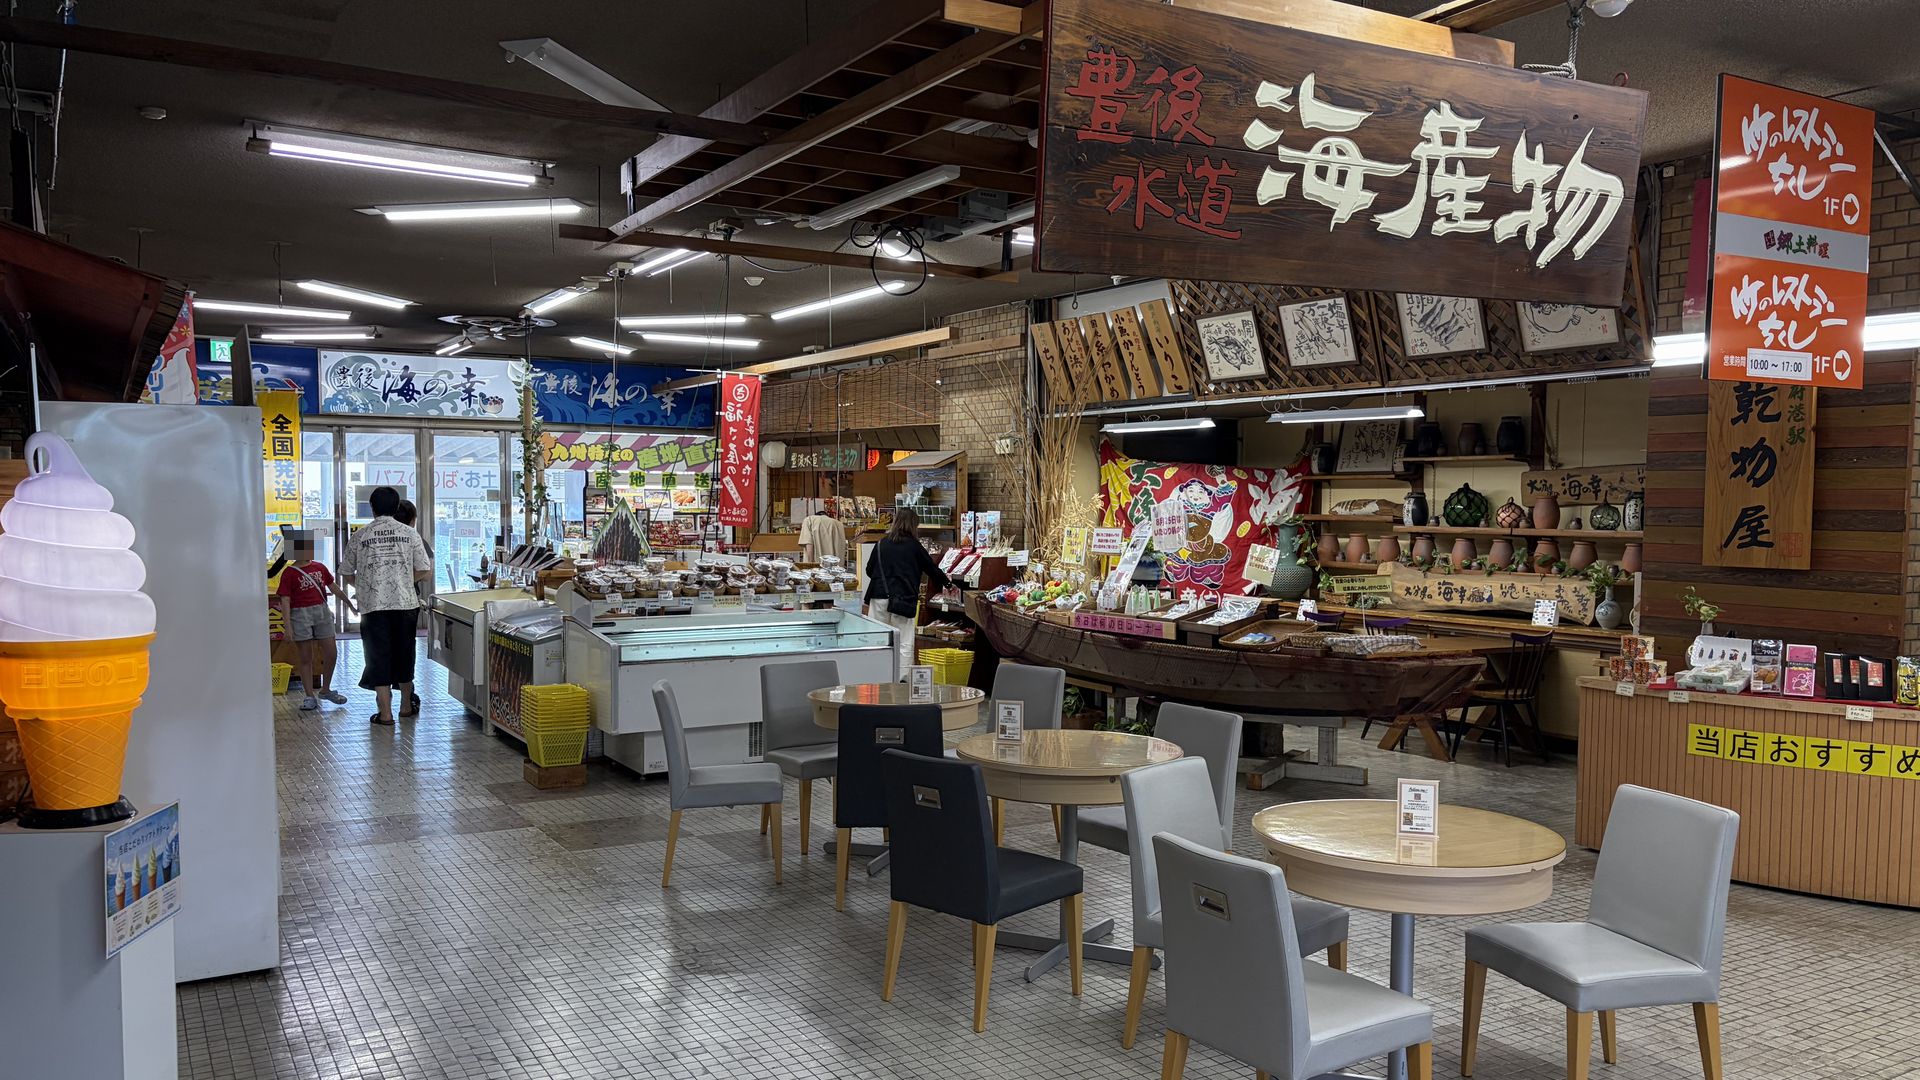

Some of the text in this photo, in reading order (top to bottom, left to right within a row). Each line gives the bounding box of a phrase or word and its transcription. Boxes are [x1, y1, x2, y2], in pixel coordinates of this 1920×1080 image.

[1065, 46, 1216, 146] 豊後
[1242, 71, 1625, 268] 海産物
[1767, 152, 1828, 200] ちくし
[1106, 155, 1242, 240] 水道
[1823, 197, 1840, 216] 1F
[1776, 230, 1830, 260] 郷土料理
[1757, 311, 1818, 350] ちくし
[1115, 314, 1145, 396] 小魚かりんとう
[1155, 336, 1183, 390] いりこ
[1723, 355, 1746, 368] 営業時間
[1749, 357, 1769, 371] 10:00
[1781, 360, 1803, 373] 17:00
[1813, 355, 1830, 373] 1F
[270, 414, 298, 501] 全国発送
[1723, 382, 1782, 549] 乾物屋
[1560, 473, 1602, 501] 海の幸
[1437, 580, 1467, 604] 海の幸
[1075, 614, 1162, 635] 今日は何の日コーナー
[1696, 728, 1920, 776] 当店おすすめ
